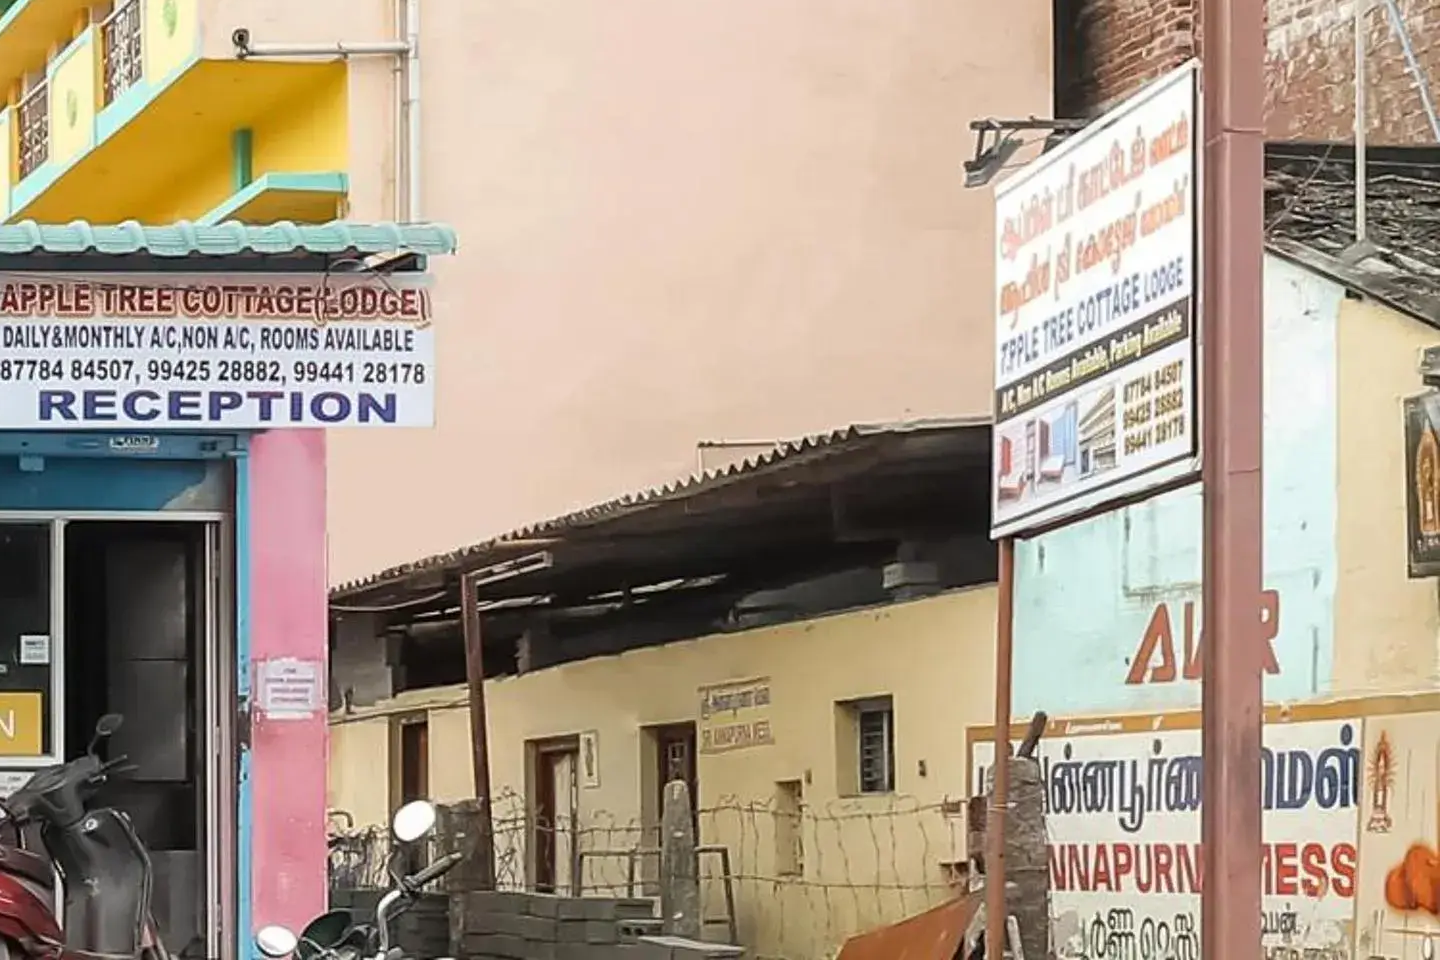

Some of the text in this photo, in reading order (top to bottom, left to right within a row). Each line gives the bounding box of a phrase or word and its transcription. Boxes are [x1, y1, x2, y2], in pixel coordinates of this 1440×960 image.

[0, 283, 91, 315] APPLE
[100, 284, 176, 316] TREE
[1043, 306, 1074, 355] TREE
[1077, 273, 1140, 335] COTTAGE
[1144, 256, 1184, 303] LODGE
[261, 328, 319, 350] ROOMS
[324, 328, 414, 352] AVAILABLE
[0, 359, 425, 386] 87784 84507, 99425 28882, 99441 28178
[38, 389, 397, 423] RECEPTION
